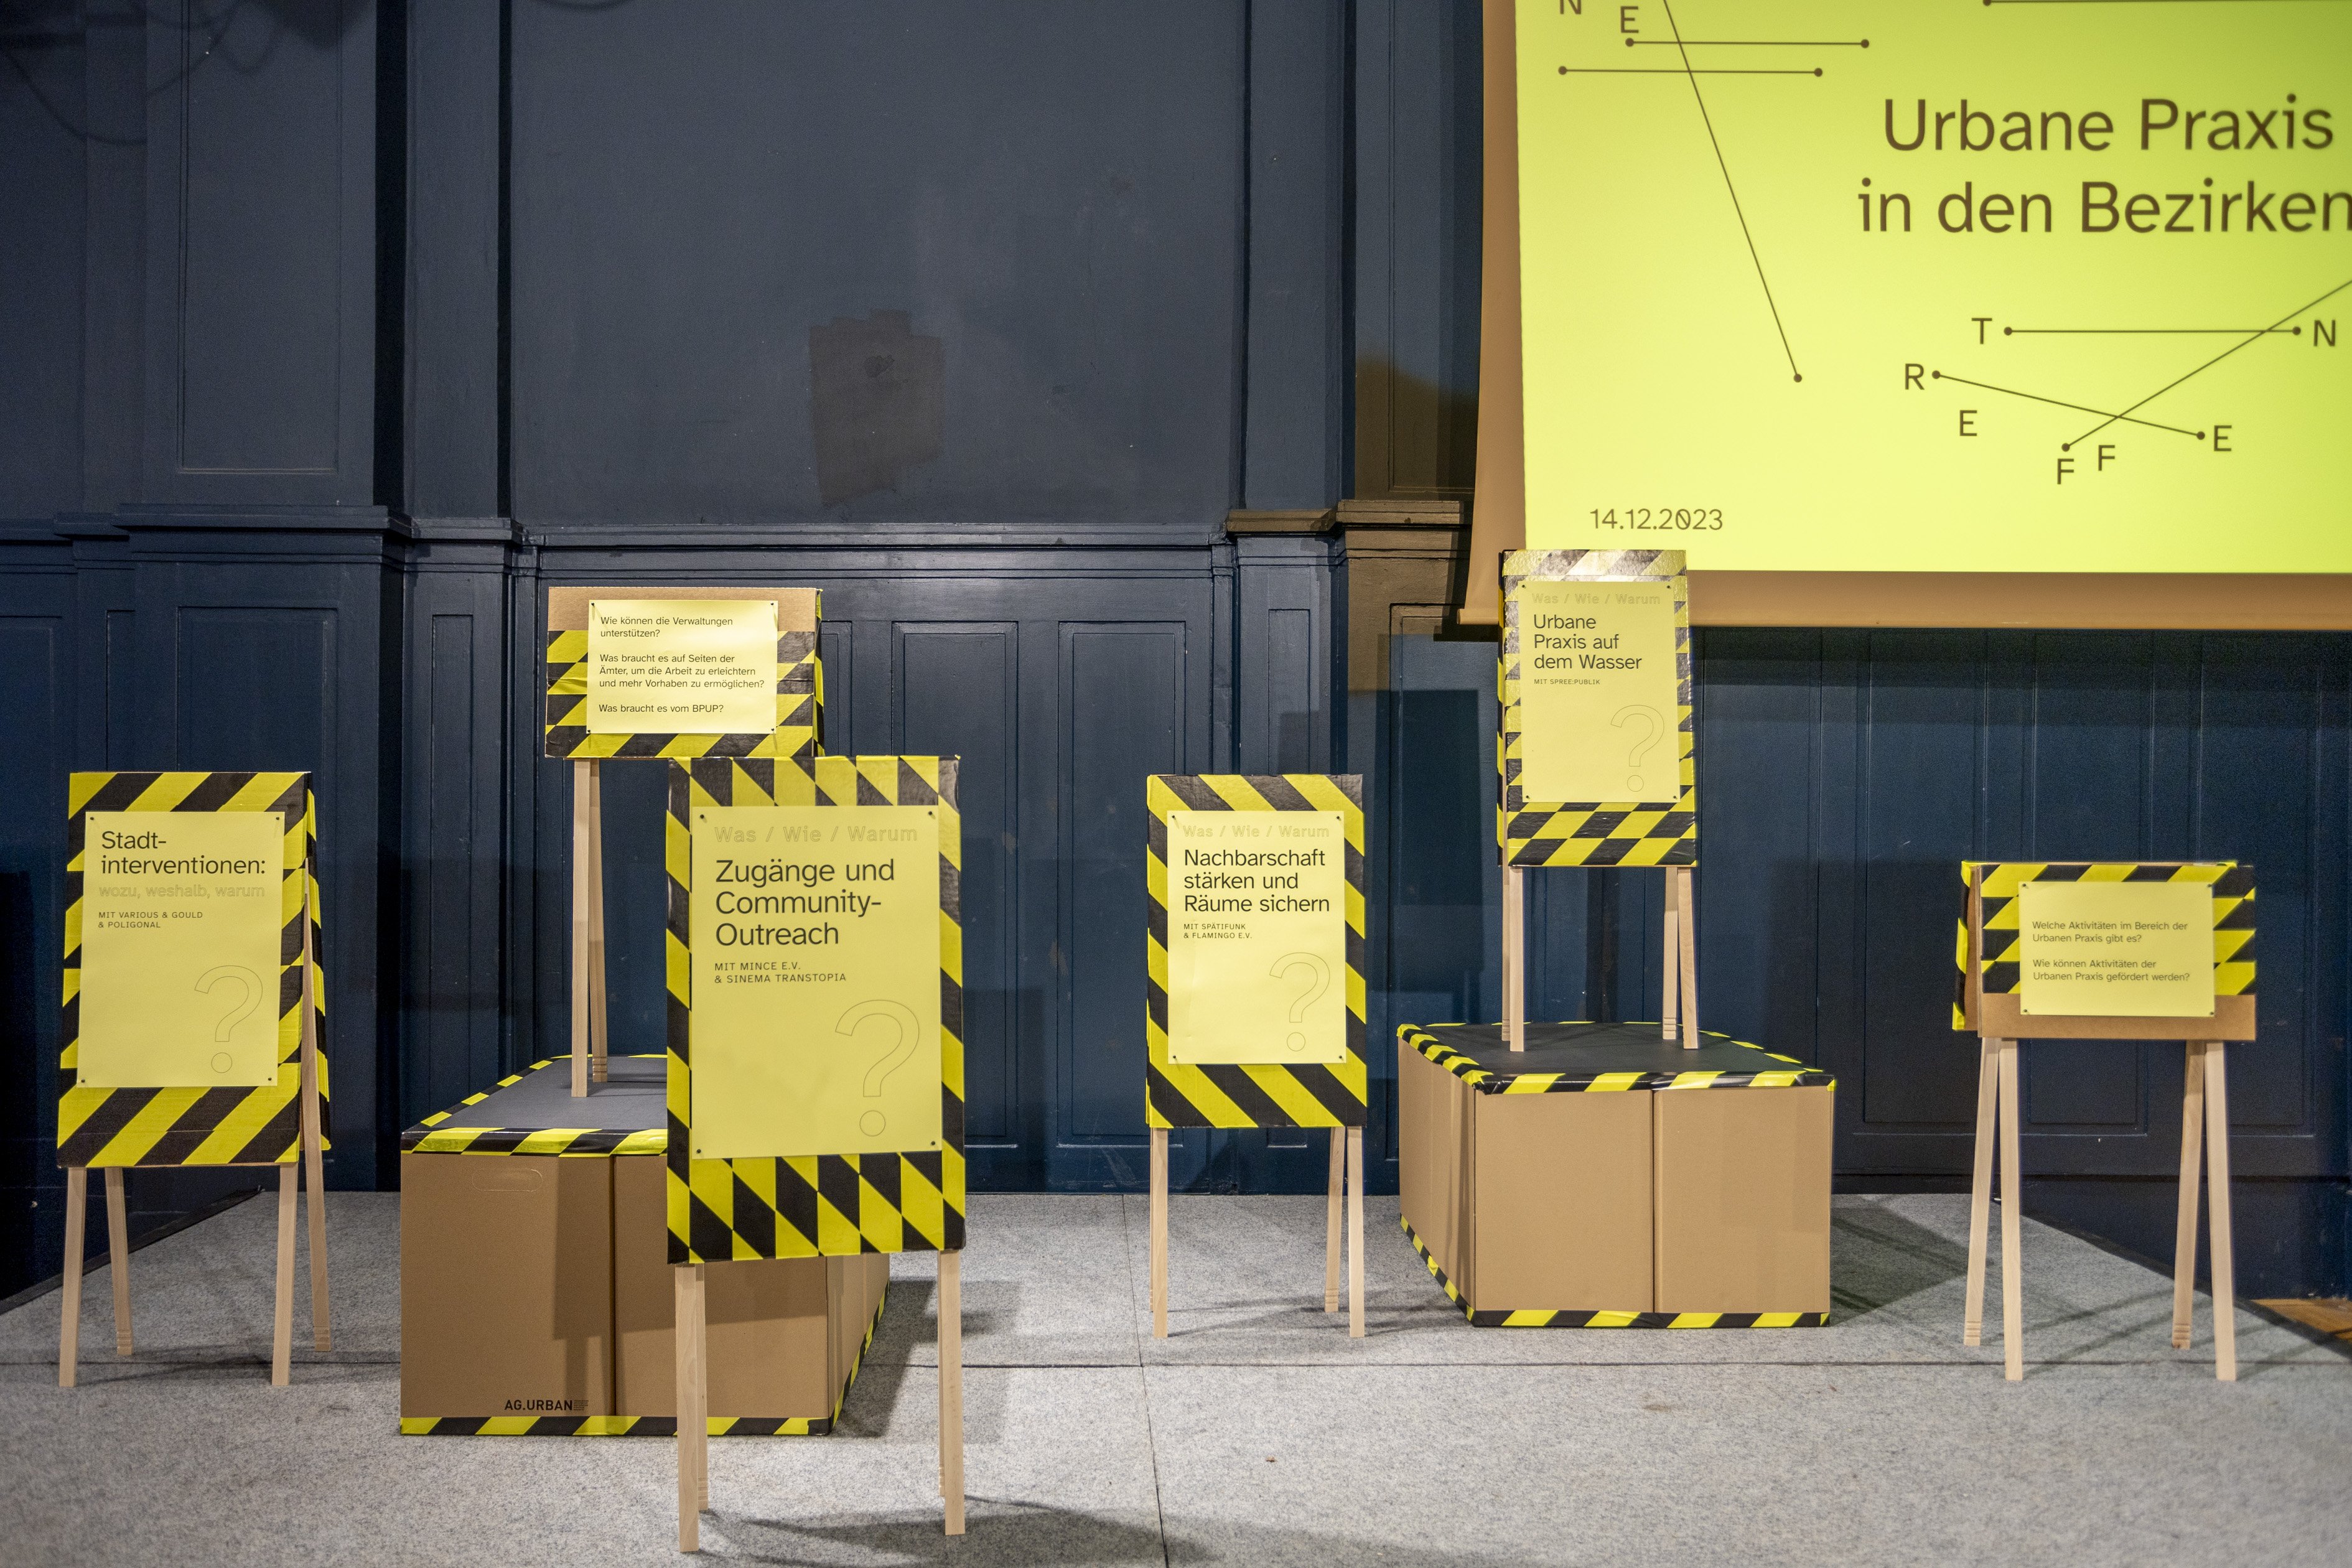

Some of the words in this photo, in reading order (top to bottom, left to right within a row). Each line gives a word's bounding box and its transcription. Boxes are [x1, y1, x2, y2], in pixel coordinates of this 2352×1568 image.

[1620, 6, 1639, 33] E
[1885, 99, 2114, 151] Urbane
[2142, 93, 2333, 150] Praxis
[1859, 177, 1910, 231] in
[1938, 182, 2051, 233] den
[2082, 177, 2352, 233] Bezirken
[1972, 318, 1992, 344] T
[2314, 320, 2336, 347] N
[1905, 363, 1924, 390] R
[1960, 410, 1977, 436] E
[2214, 426, 2232, 451] E
[2099, 445, 2115, 471] F
[2058, 459, 2074, 484] F
[1590, 508, 1722, 530] 14.12.2023
[1531, 593, 1559, 605] Was
[1575, 594, 1600, 604] Wie
[1615, 594, 1660, 605] Warum
[656, 617, 670, 625] die
[673, 617, 732, 627] Verwaltungen
[1534, 615, 1596, 629] Urbane
[1534, 633, 1586, 649] Praxis
[1593, 634, 1619, 649] auf
[600, 667, 628, 675] Ämter,
[648, 666, 662, 674] die
[708, 667, 755, 675] erleichtern
[1534, 655, 1572, 668] dem
[1579, 655, 1642, 669] Wasser
[704, 679, 764, 689] ermöglichen?
[693, 704, 724, 712] BPUP?
[1610, 705, 1664, 792] ?
[102, 831, 166, 849] Stadt-
[714, 826, 757, 843] Was
[782, 826, 821, 842] Wie
[847, 826, 918, 842] Warum
[1183, 826, 1213, 838] Was
[1232, 826, 1260, 837] Wie
[1279, 826, 1330, 838] Warum
[101, 855, 264, 874] interventionen:
[1185, 849, 1325, 866] Nachbarschaft
[716, 859, 834, 888] Zugänge
[846, 859, 894, 881] und
[1185, 872, 1254, 889] stärken
[1263, 872, 1298, 889] und
[99, 885, 141, 900] wozu,
[146, 884, 212, 899] weshalb,
[215, 885, 265, 897] warum
[716, 887, 881, 917] Community-
[1185, 895, 1252, 912] Räume
[1260, 894, 1329, 912] sichern
[716, 922, 838, 946] Outreach
[2069, 922, 2117, 930] Aktivitäten
[2135, 922, 2169, 930] Bereich
[2075, 934, 2102, 942] Praxis
[2106, 934, 2123, 944] gibt
[715, 963, 735, 971] MIT
[2089, 959, 2138, 968] Aktivitäten
[2141, 959, 2157, 968] der
[727, 975, 770, 983] SINEMA
[775, 974, 846, 982] TRANSTOPIA
[2106, 973, 2148, 982] gefördert
[1269, 952, 1330, 1052] ?
[194, 965, 263, 1073] ?
[835, 999, 919, 1137] ?
[505, 1400, 572, 1411] AG.URBAN
